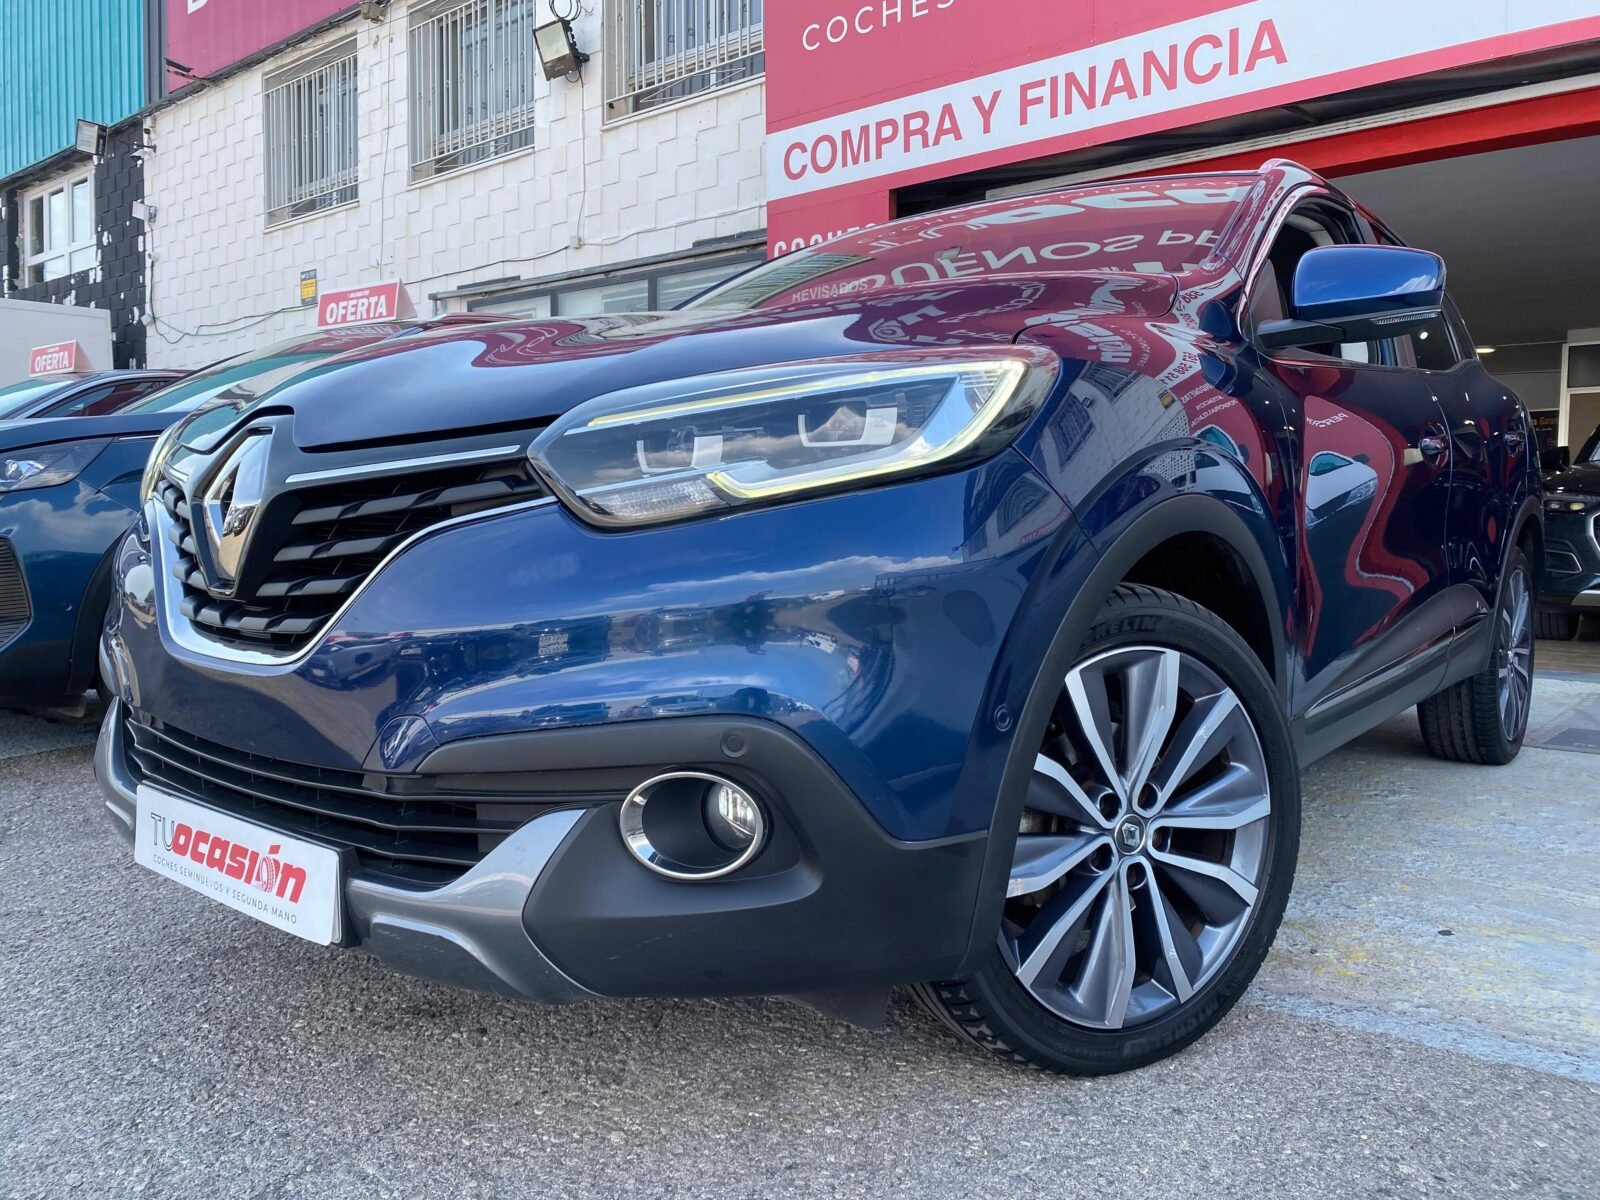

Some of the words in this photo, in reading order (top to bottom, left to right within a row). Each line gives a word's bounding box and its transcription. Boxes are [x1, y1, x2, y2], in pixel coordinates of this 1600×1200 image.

[782, 103, 963, 181] COMPRA
[972, 90, 1002, 135] Y
[1018, 19, 1288, 126] FINANCIA
[325, 294, 388, 325] OFERTA
[34, 351, 69, 372] OFERTA
[152, 854, 178, 872] COCHES
[179, 866, 224, 895] SEMINUEVOS
[231, 890, 269, 913] SEGUNDA
[271, 906, 298, 925] MANO
